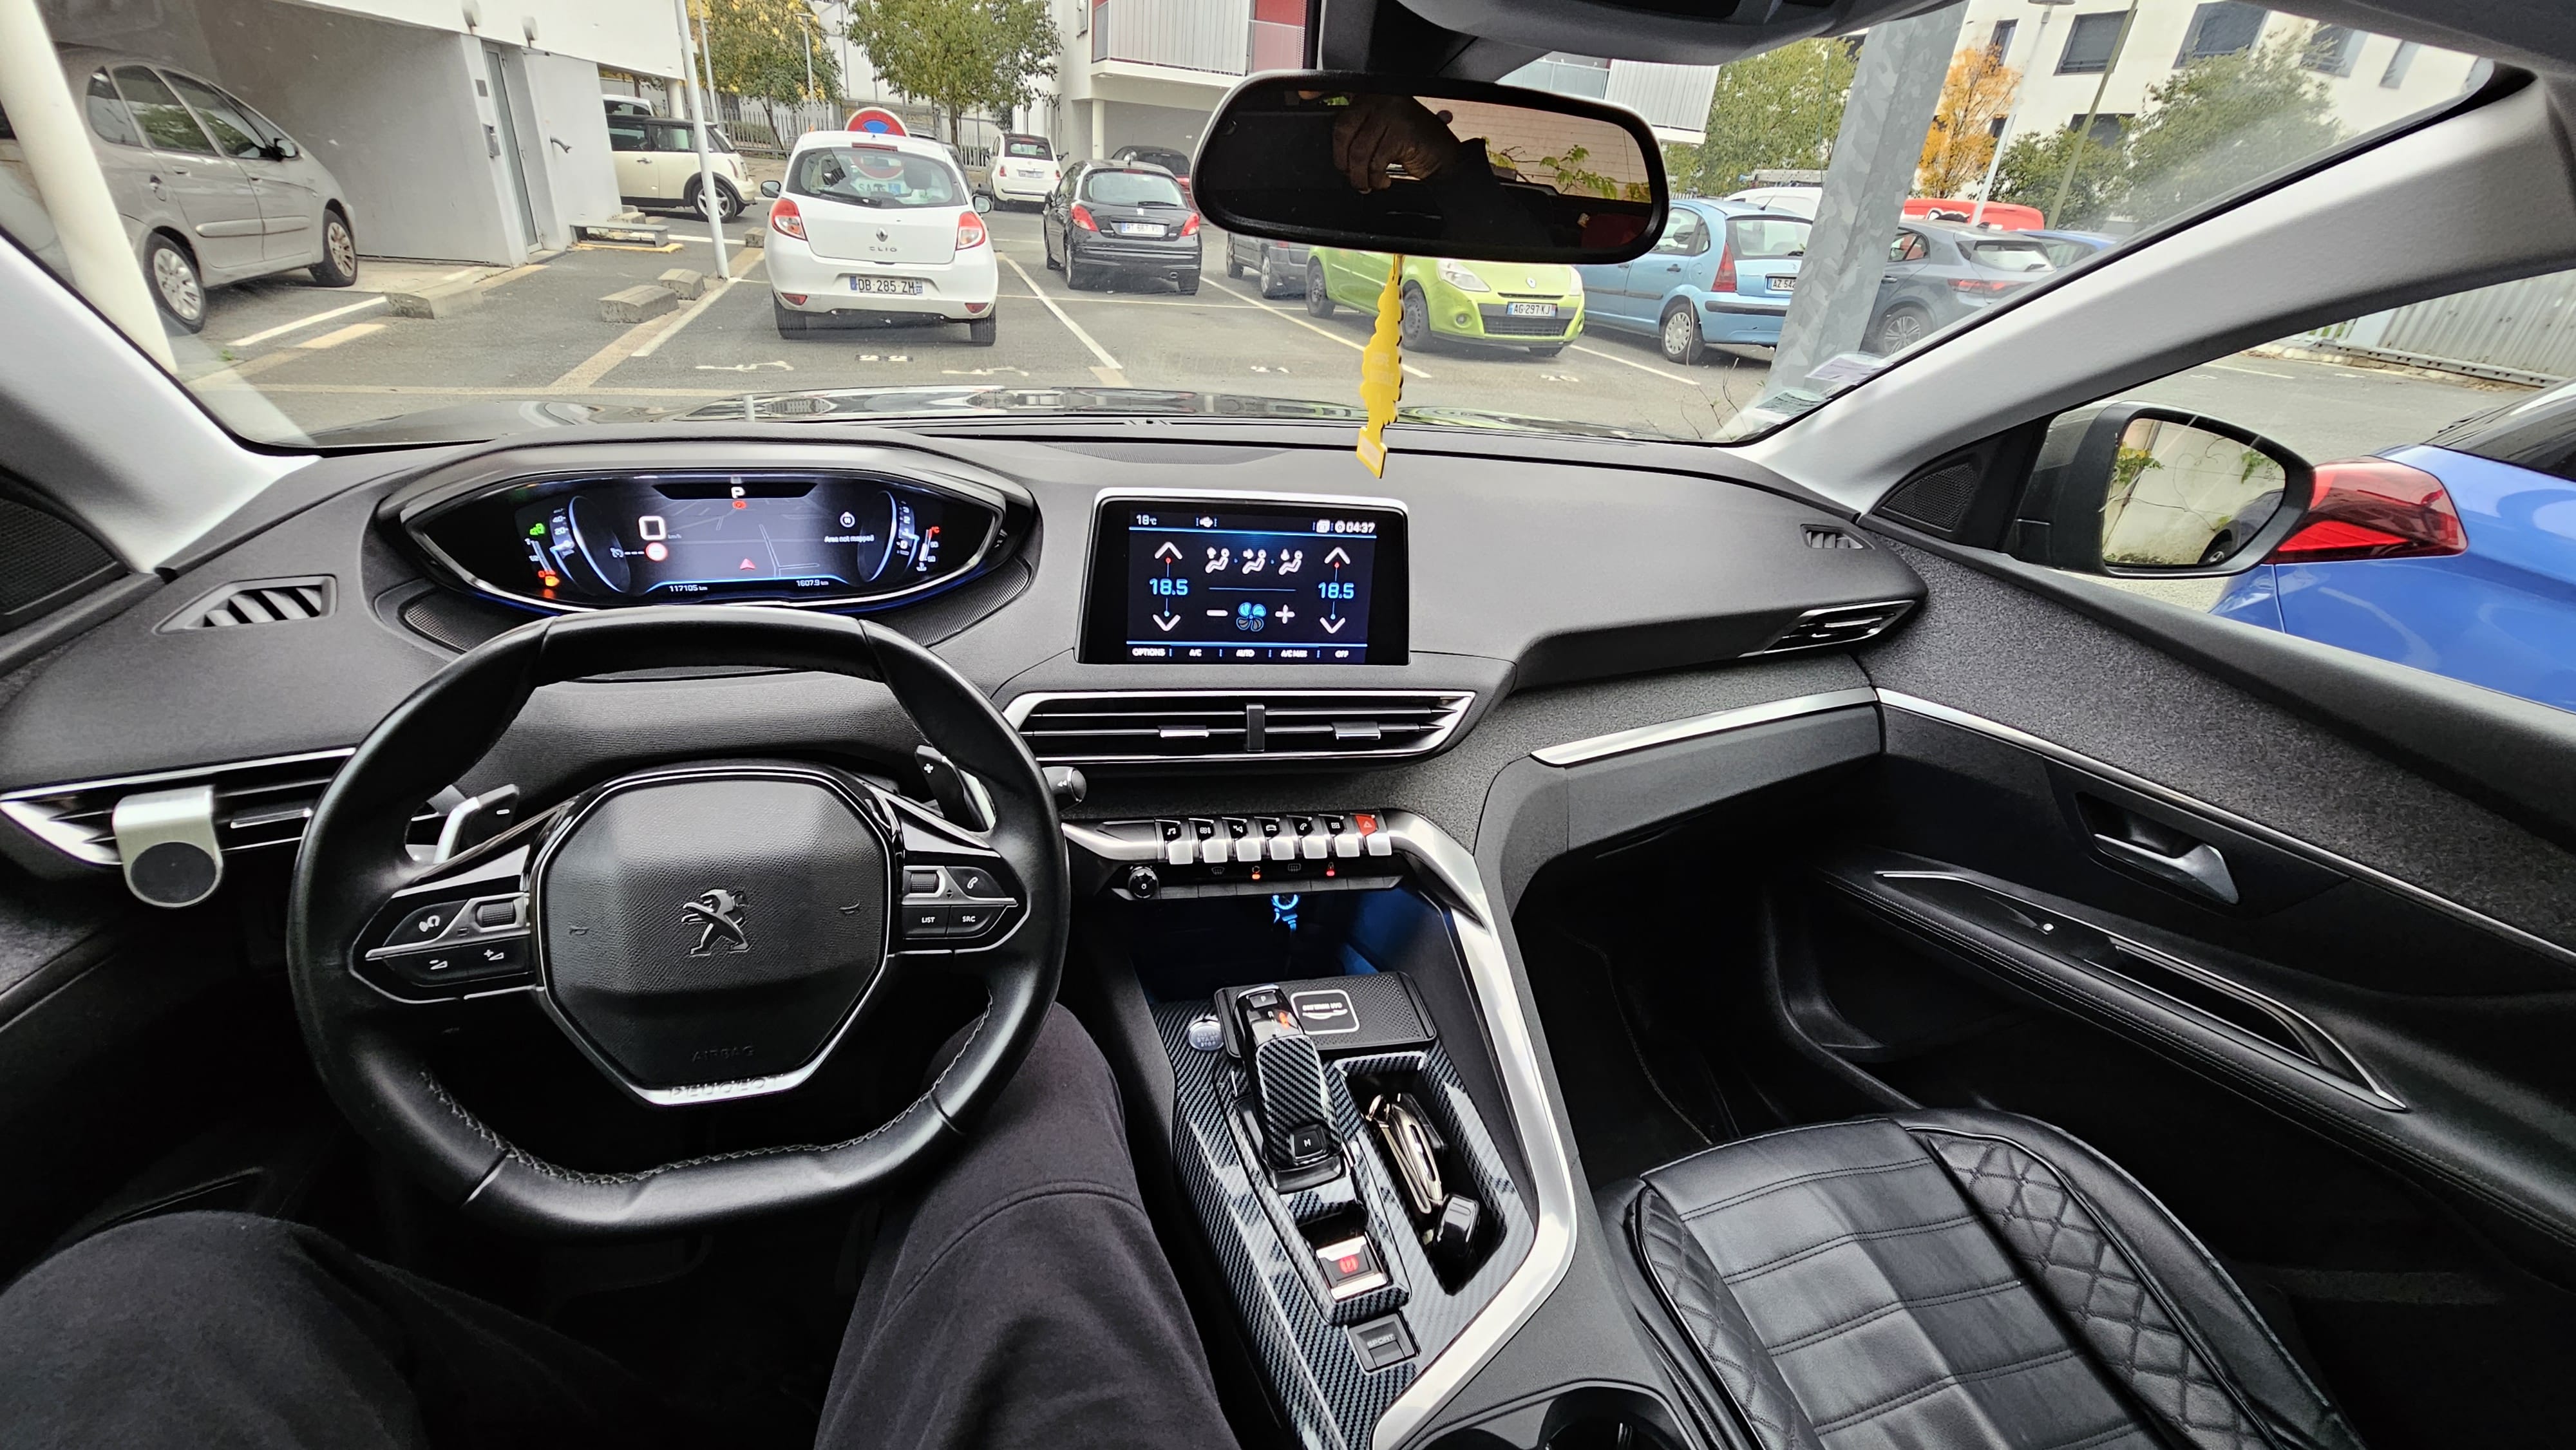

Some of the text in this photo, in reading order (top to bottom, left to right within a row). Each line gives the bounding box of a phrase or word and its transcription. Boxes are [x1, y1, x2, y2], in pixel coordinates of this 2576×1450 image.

[876, 279, 896, 293] 285
[1525, 304, 1540, 315] 297
[731, 487, 746, 499] P
[638, 516, 667, 540] 0
[1150, 578, 1188, 596] 18.5
[1318, 581, 1355, 599] 18.5
[1132, 648, 1166, 657] OPTIONS
[1236, 649, 1255, 657] AUTO
[1334, 650, 1349, 658] OFF
[1303, 1138, 1312, 1147] M
[1367, 1333, 1396, 1348] SPORT
